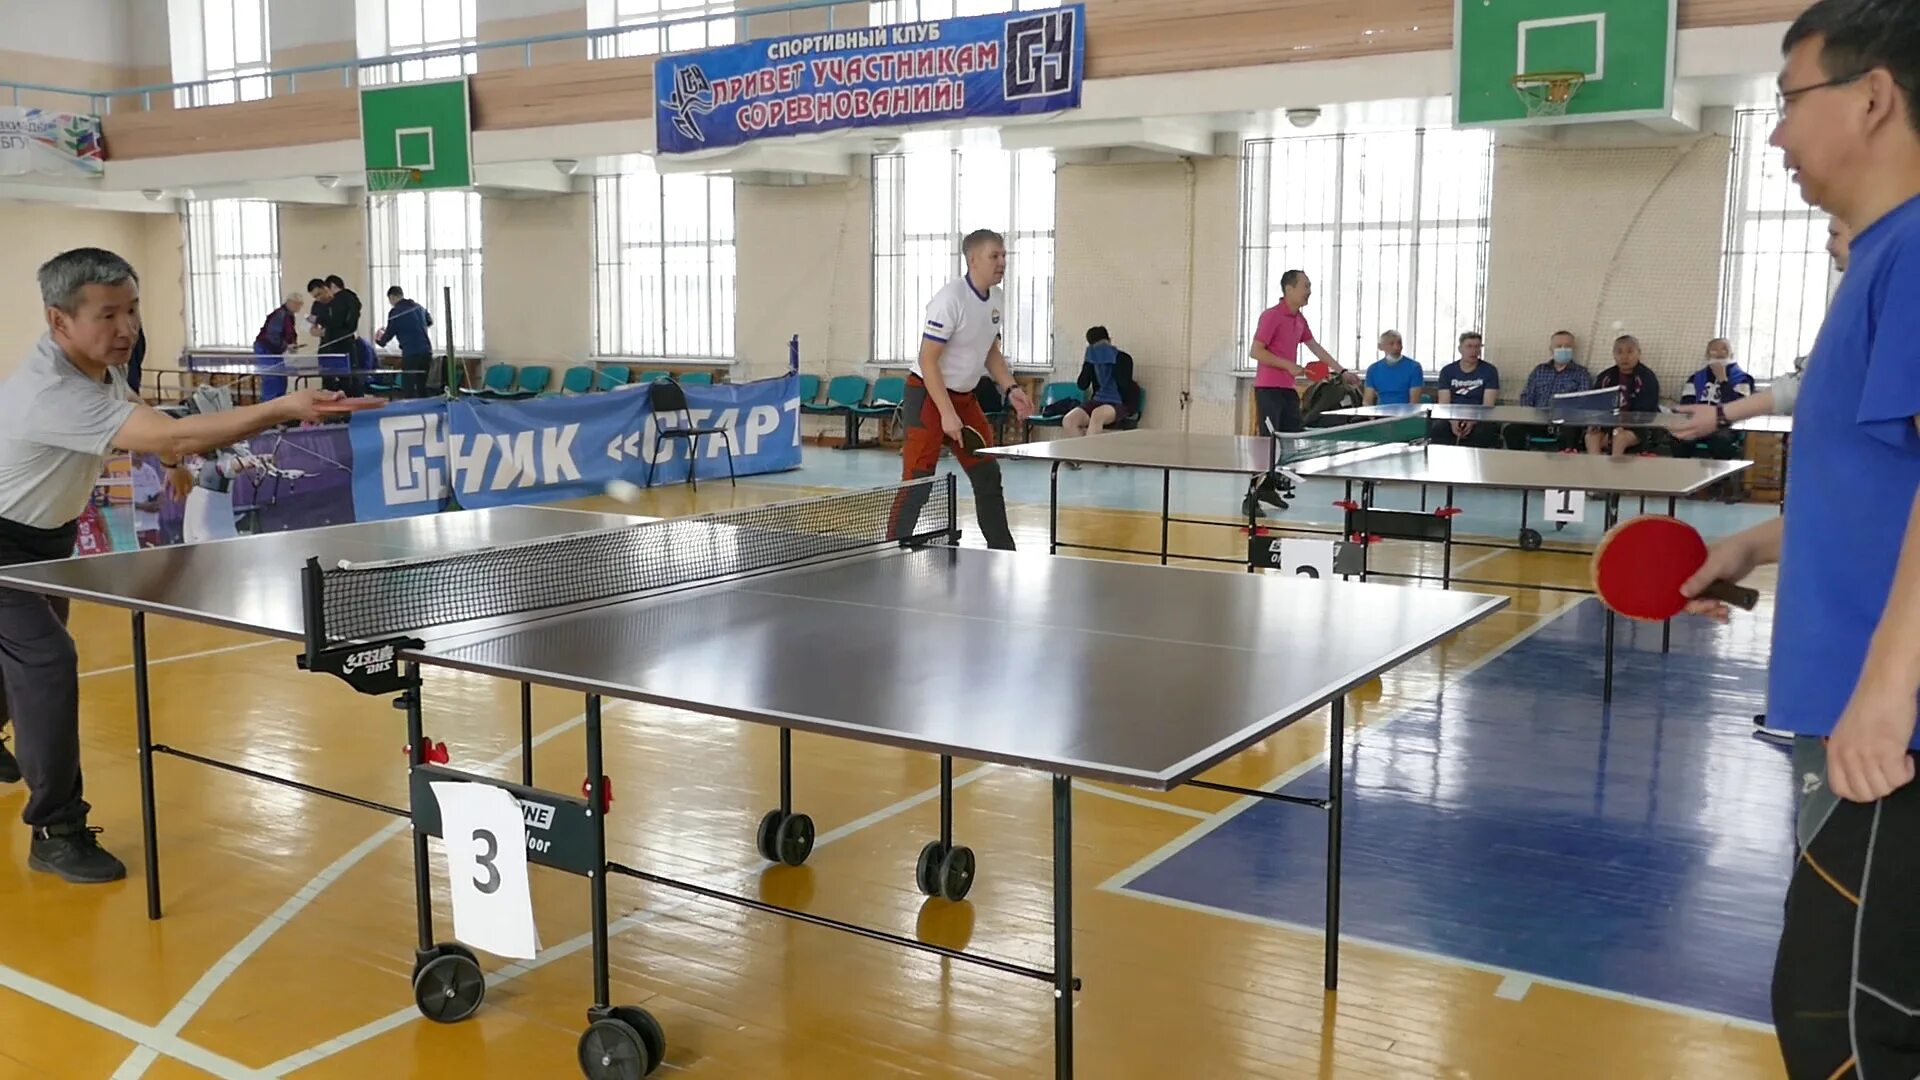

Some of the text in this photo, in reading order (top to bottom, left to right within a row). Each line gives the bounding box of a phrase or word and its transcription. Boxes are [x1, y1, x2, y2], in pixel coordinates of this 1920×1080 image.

[768, 22, 940, 60] СПОРТИВНЫЙ КЛУБ
[711, 40, 999, 107] ПРИВЕТ УЧАСТНИКАМ
[736, 78, 964, 132] СОРЕВНОВАНИЙ!
[1556, 490, 1575, 514] 1
[472, 829, 501, 895] 3
